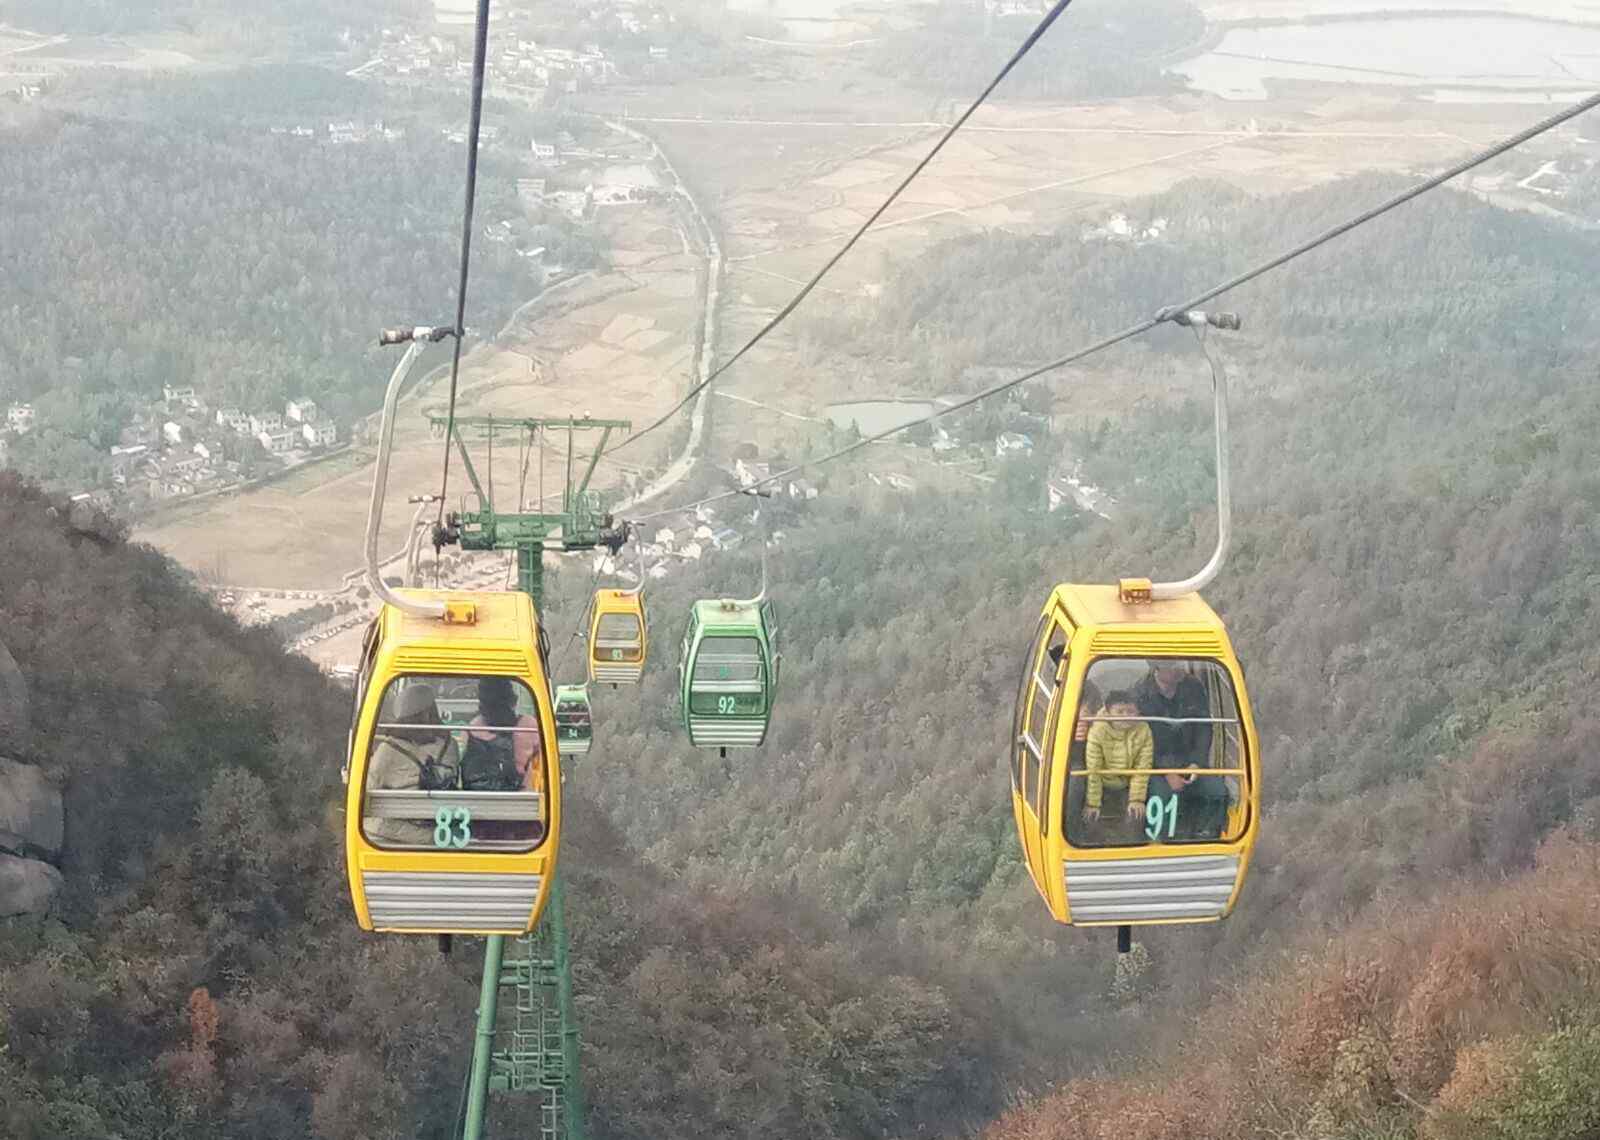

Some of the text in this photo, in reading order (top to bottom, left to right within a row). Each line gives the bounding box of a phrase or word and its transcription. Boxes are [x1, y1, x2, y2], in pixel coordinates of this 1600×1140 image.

[718, 695, 735, 714] 92
[434, 806, 471, 848] 83
[1145, 794, 1178, 840] 91
